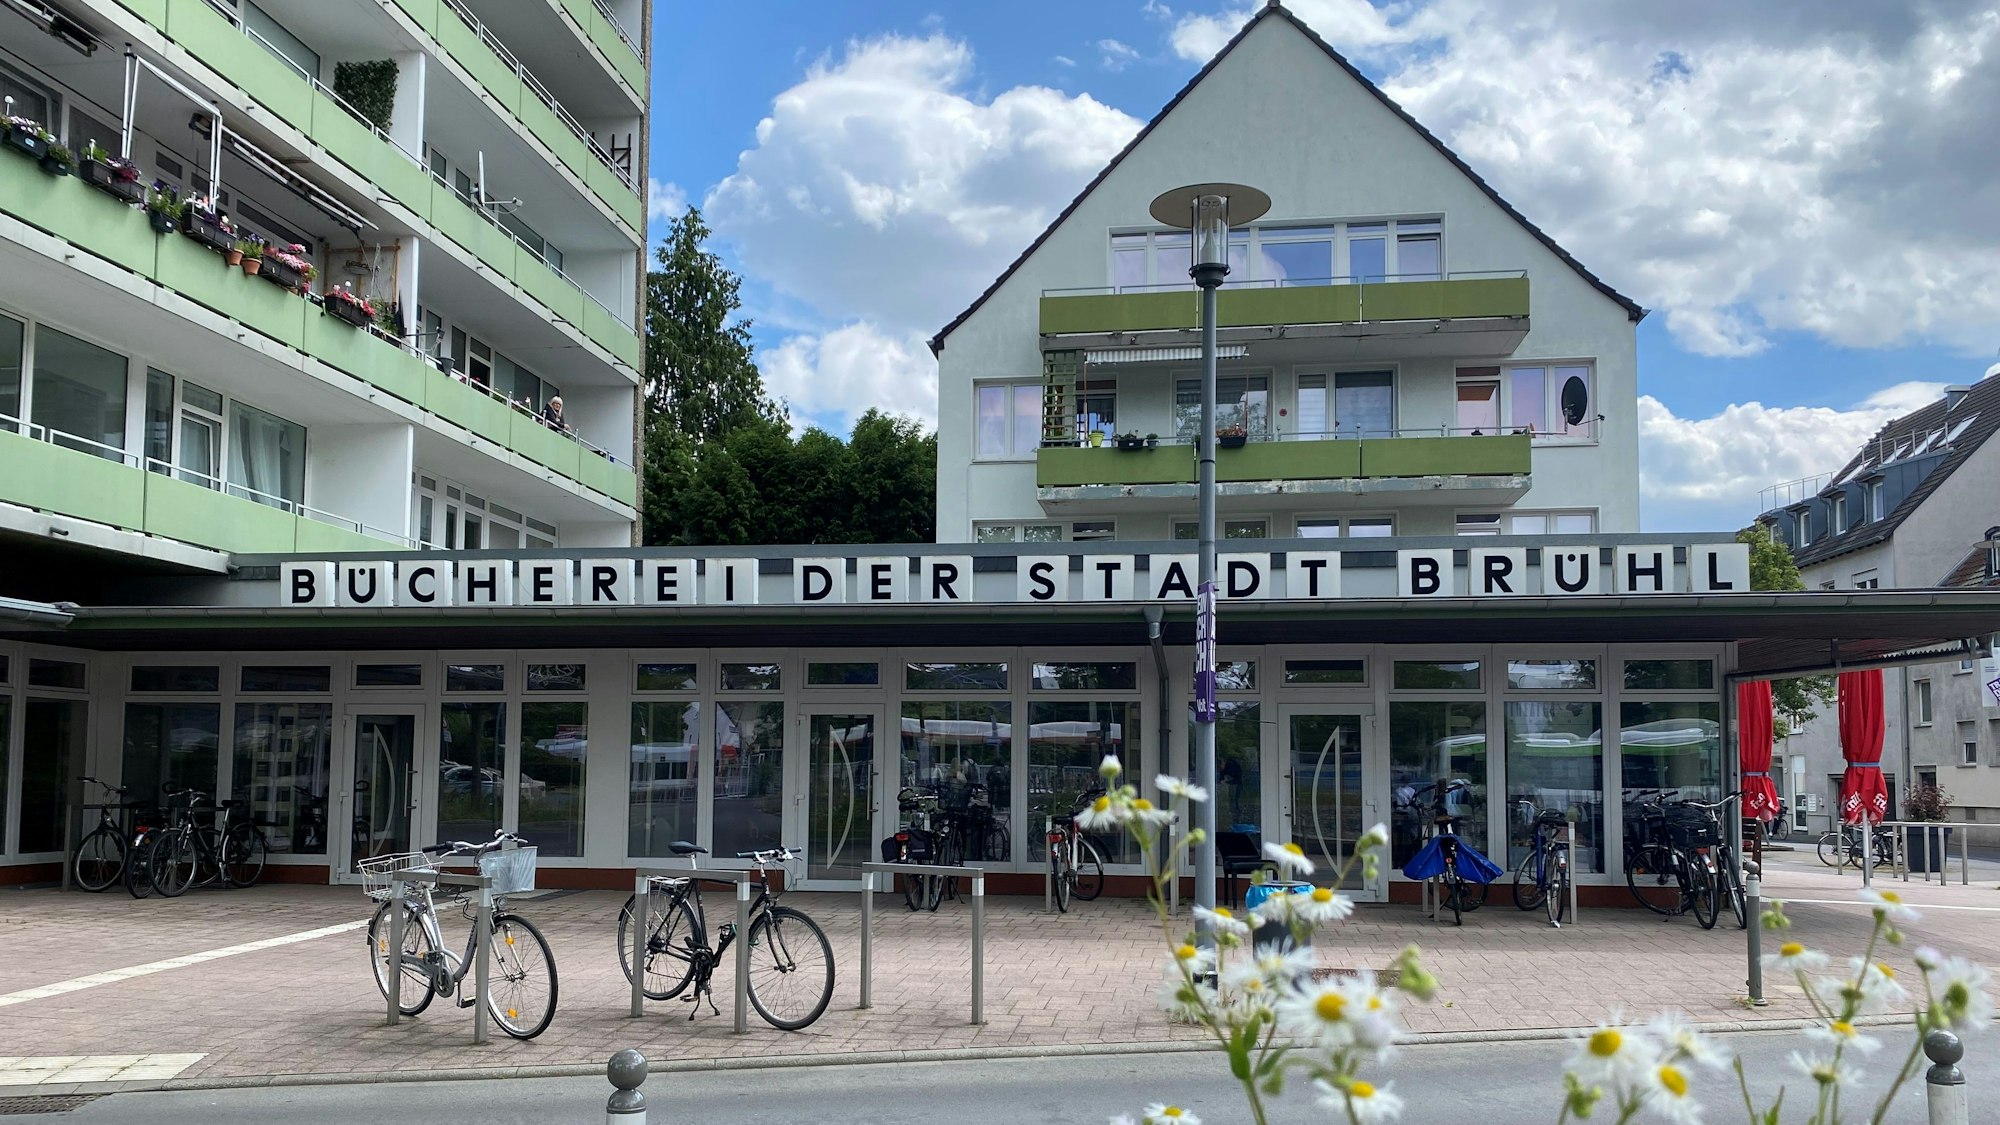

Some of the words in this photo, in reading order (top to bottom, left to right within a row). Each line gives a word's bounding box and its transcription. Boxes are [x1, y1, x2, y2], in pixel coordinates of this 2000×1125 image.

[291, 565, 733, 604] BÜCHEREI
[802, 562, 958, 601] DER
[1029, 559, 1327, 600] STADT
[1411, 551, 1733, 595] BRÜHL
